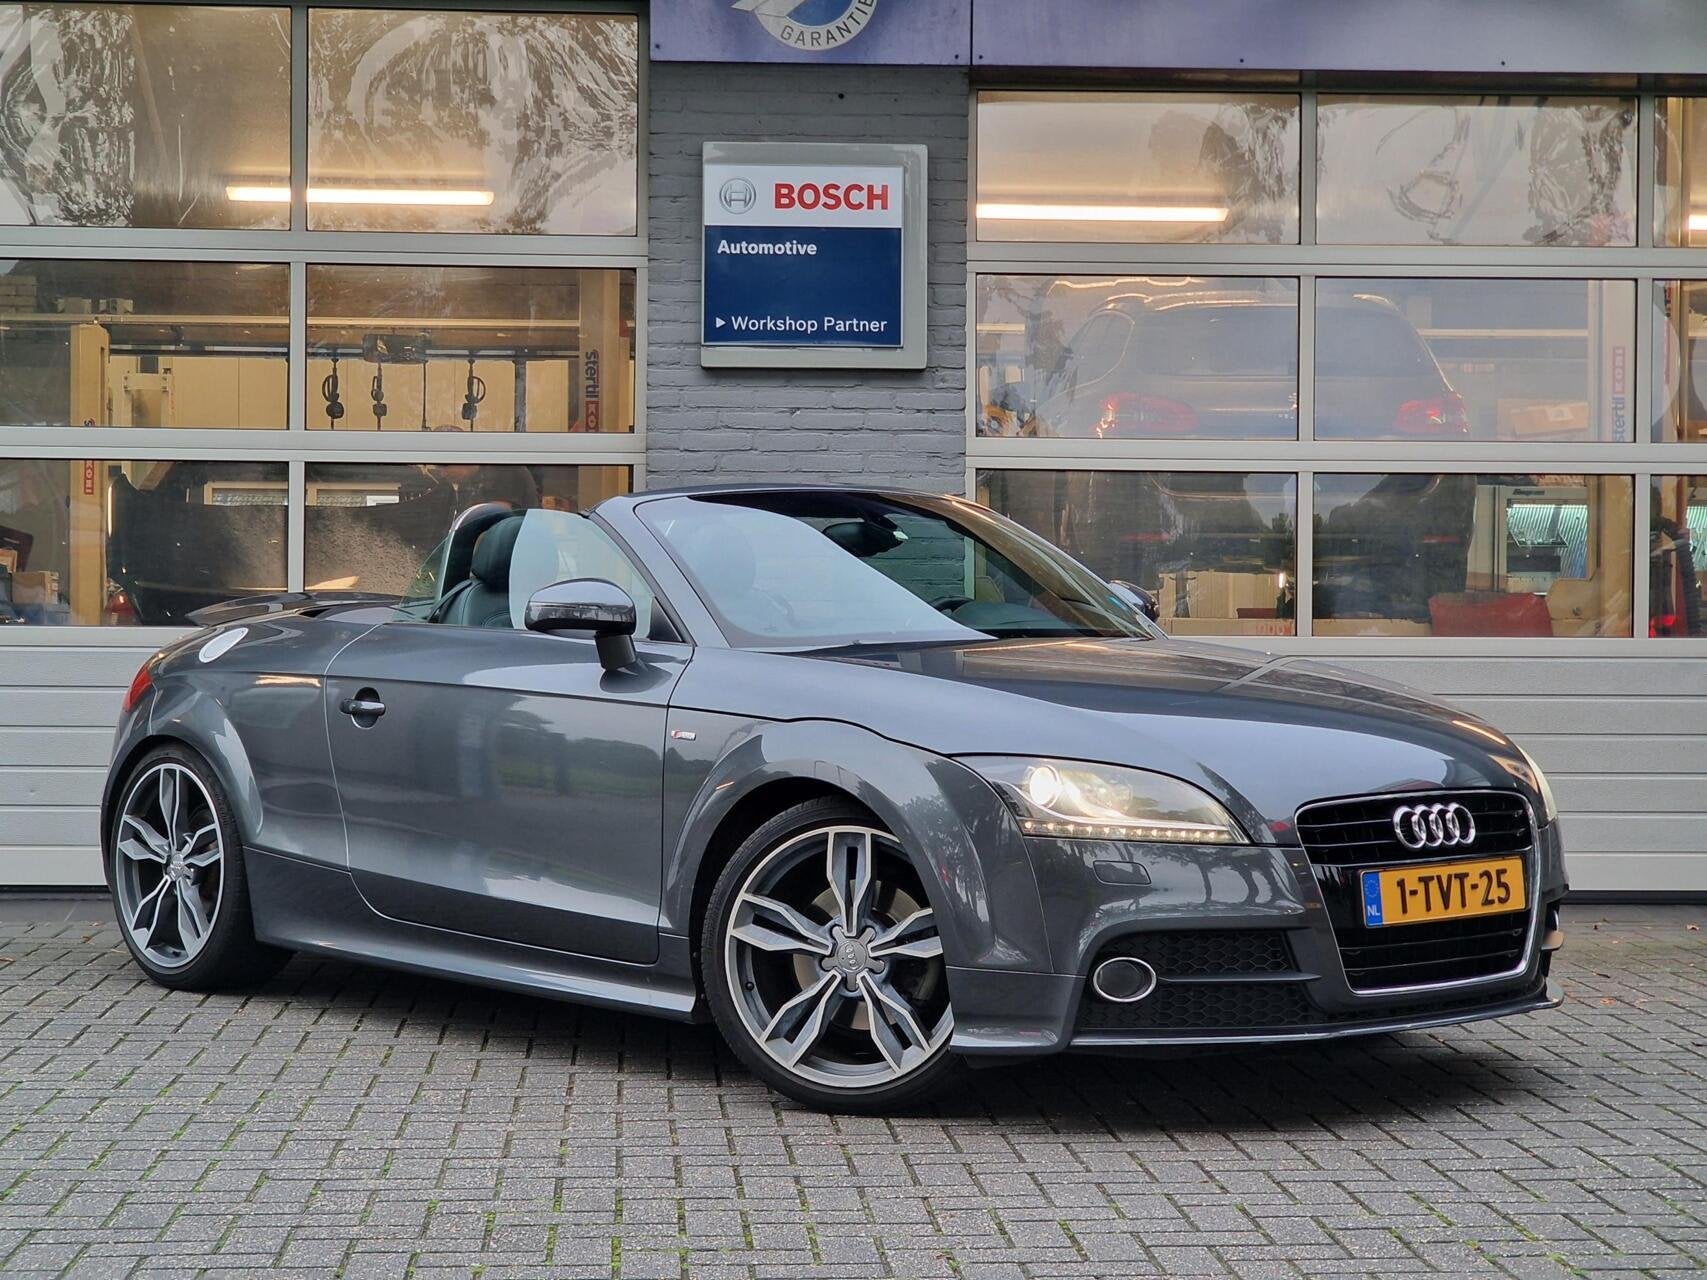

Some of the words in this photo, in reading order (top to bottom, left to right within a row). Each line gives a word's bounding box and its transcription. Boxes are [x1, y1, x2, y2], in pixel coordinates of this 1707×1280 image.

[774, 183, 889, 210] BOSCH
[717, 240, 817, 255] Automotive
[731, 316, 818, 333] Workshop
[824, 316, 887, 332] Partner
[1396, 868, 1510, 914] 1-TVT-25
[1367, 904, 1381, 917] NL
